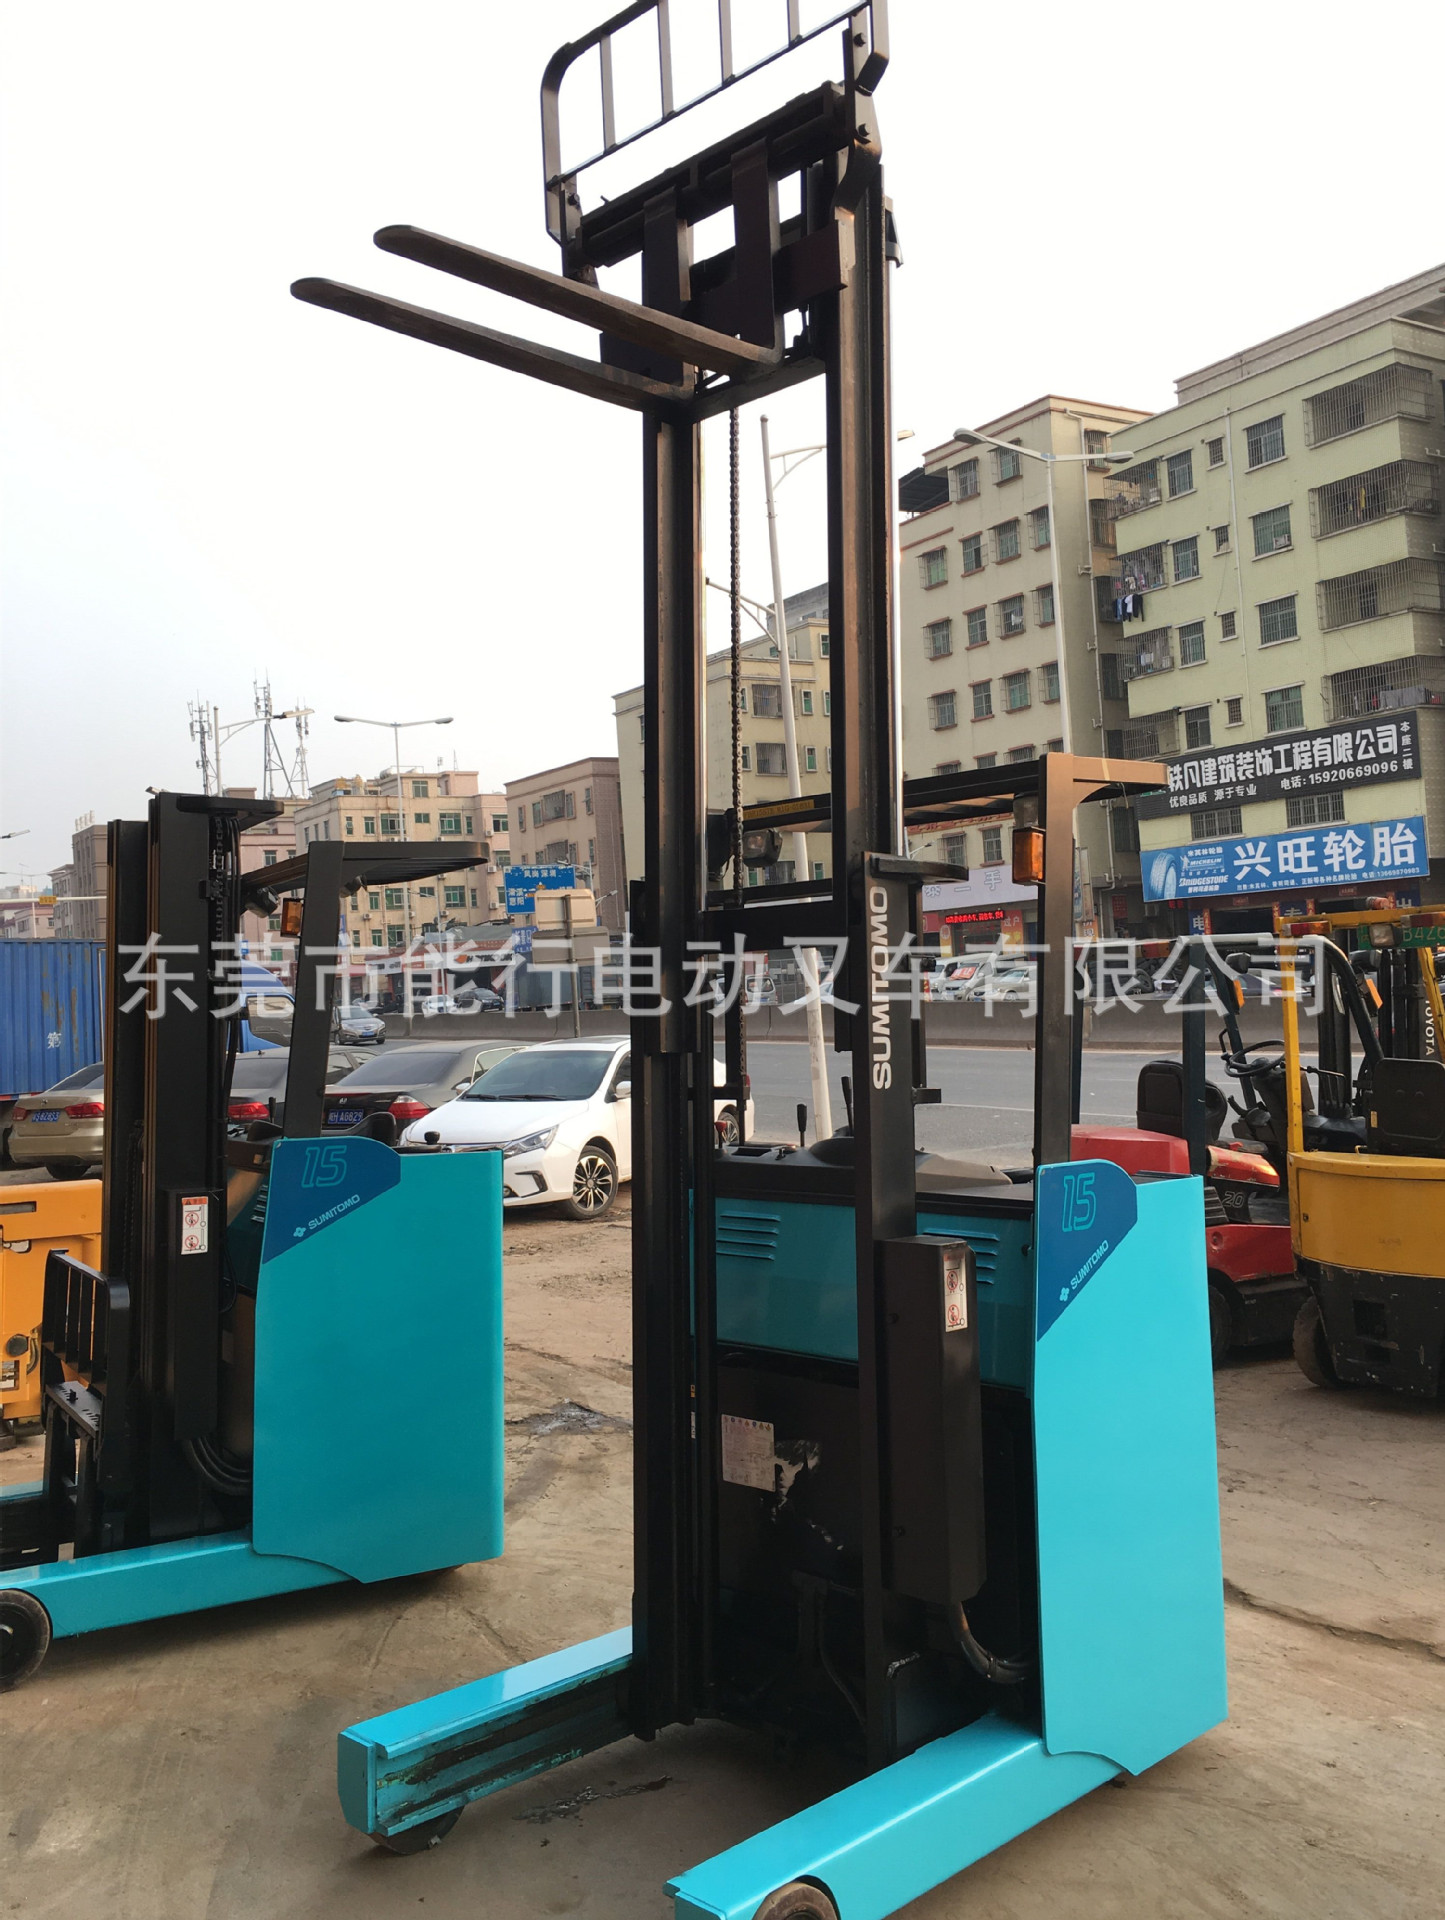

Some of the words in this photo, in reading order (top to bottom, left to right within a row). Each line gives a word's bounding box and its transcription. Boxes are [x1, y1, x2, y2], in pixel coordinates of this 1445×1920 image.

[1169, 791, 1208, 808] 优良品质
[1214, 783, 1257, 801] 源于专业
[1233, 823, 1417, 880] 兴旺轮胎
[869, 886, 892, 1090] SUMITOMO
[302, 1145, 347, 1188] 15
[308, 1194, 360, 1230] SUMITOMO
[1062, 1172, 1097, 1232] 15
[1222, 1191, 1244, 1208] 20
[1070, 1240, 1109, 1290] SUMITOMO
